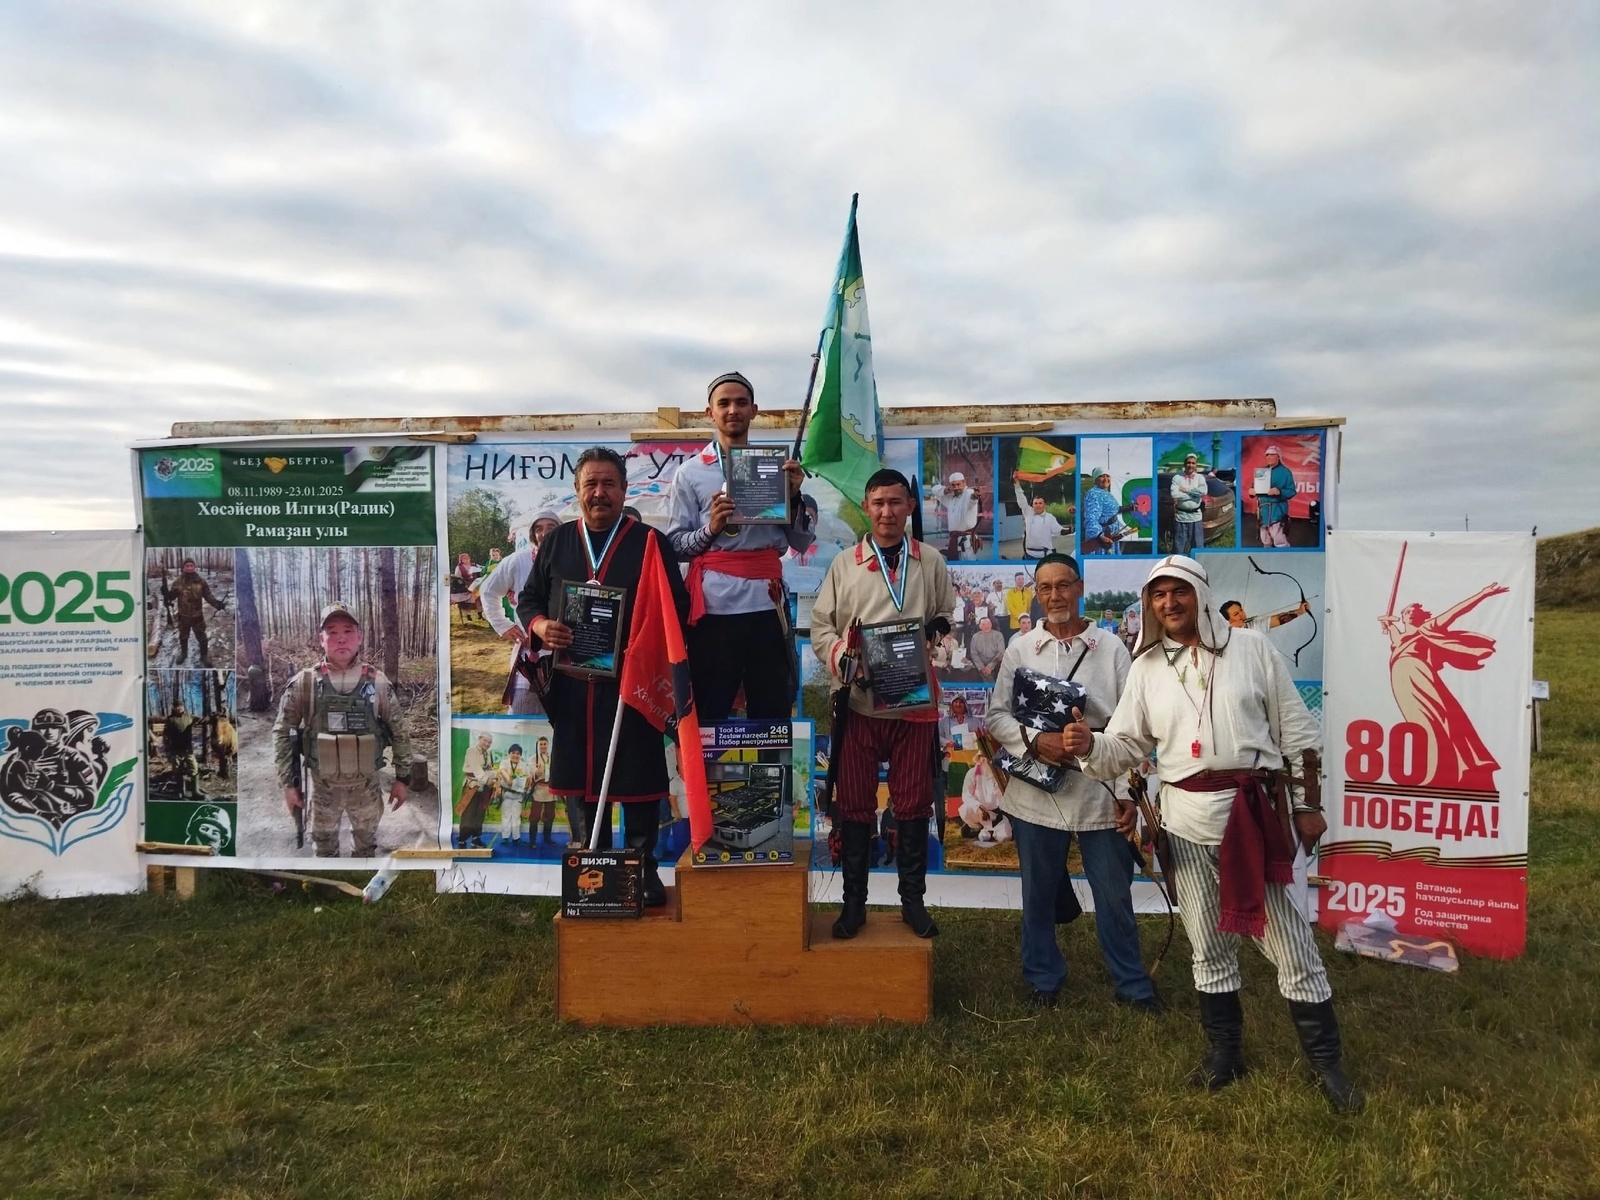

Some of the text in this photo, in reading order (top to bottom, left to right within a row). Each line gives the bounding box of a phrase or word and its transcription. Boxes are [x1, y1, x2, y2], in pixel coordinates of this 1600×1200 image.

[178, 457, 215, 472] 2025
[228, 487, 283, 497] 08.11.1989
[198, 501, 281, 516] Хөсәйенов
[246, 523, 348, 541] Рамаҙан улы
[0, 571, 135, 625] 025
[67, 677, 93, 685] СЕМЕЙ
[770, 726, 788, 735] 246
[742, 738, 789, 746] инструментов
[1345, 719, 1428, 786] 80
[1343, 795, 1499, 841] ПОБЕДА!
[581, 857, 617, 866] ВИХРЬ
[1415, 881, 1462, 895] Ватанды
[1327, 881, 1406, 917] 2025
[1487, 901, 1520, 910] йылы
[1414, 907, 1492, 924] Год защитника
[1414, 917, 1469, 930] Отечества
